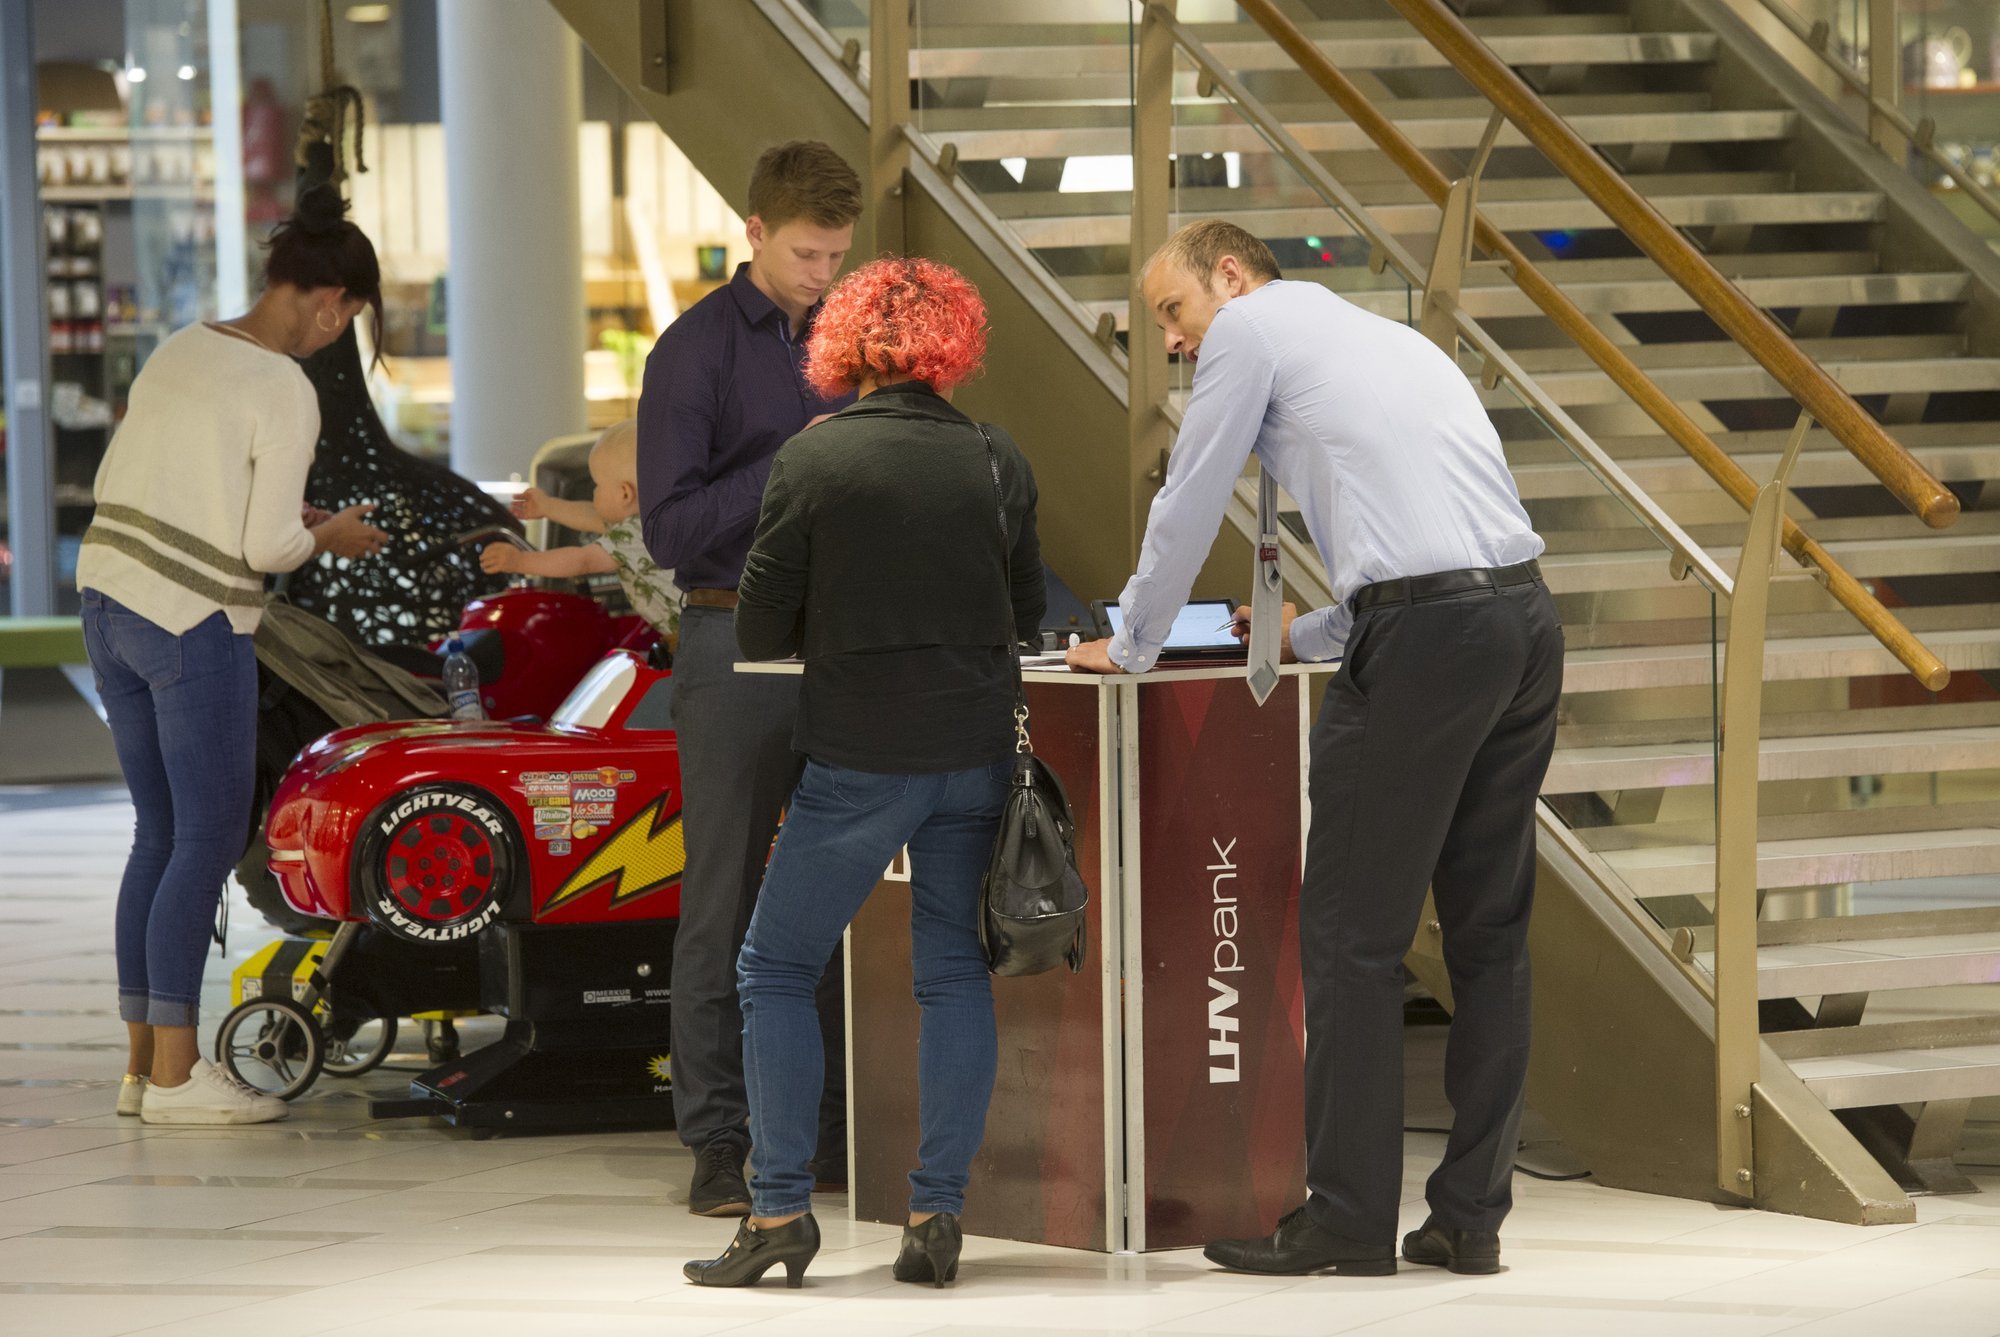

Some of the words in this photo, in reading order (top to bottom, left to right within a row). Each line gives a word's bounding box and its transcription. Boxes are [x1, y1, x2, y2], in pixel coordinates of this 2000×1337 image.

[574, 789, 616, 801] MOOD
[380, 793, 504, 836] LIGHTYEAR
[587, 803, 613, 815] Stall
[378, 899, 501, 941] LIGHTYEAR
[596, 989, 631, 997] MERKUR
